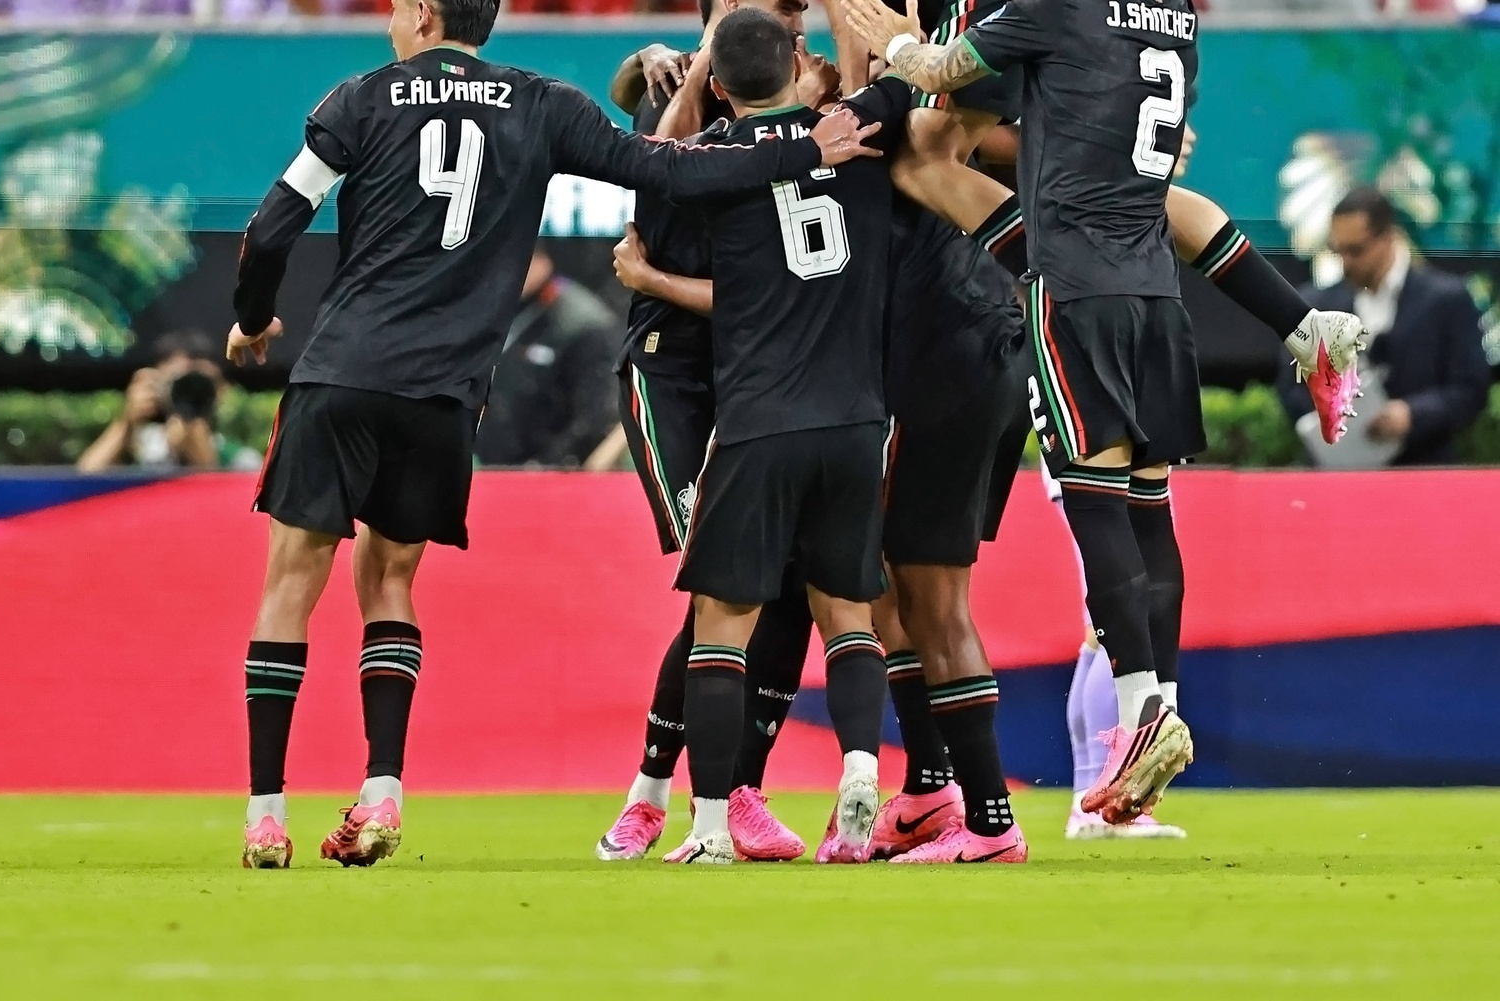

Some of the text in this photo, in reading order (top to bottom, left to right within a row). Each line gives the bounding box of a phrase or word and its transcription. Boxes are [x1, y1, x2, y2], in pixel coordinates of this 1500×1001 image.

[390, 76, 512, 109] E.ÁLVAREZ
[1131, 47, 1185, 180] 2
[418, 118, 485, 250] 4
[771, 164, 851, 281] 6
[1027, 375, 1048, 432] 2
